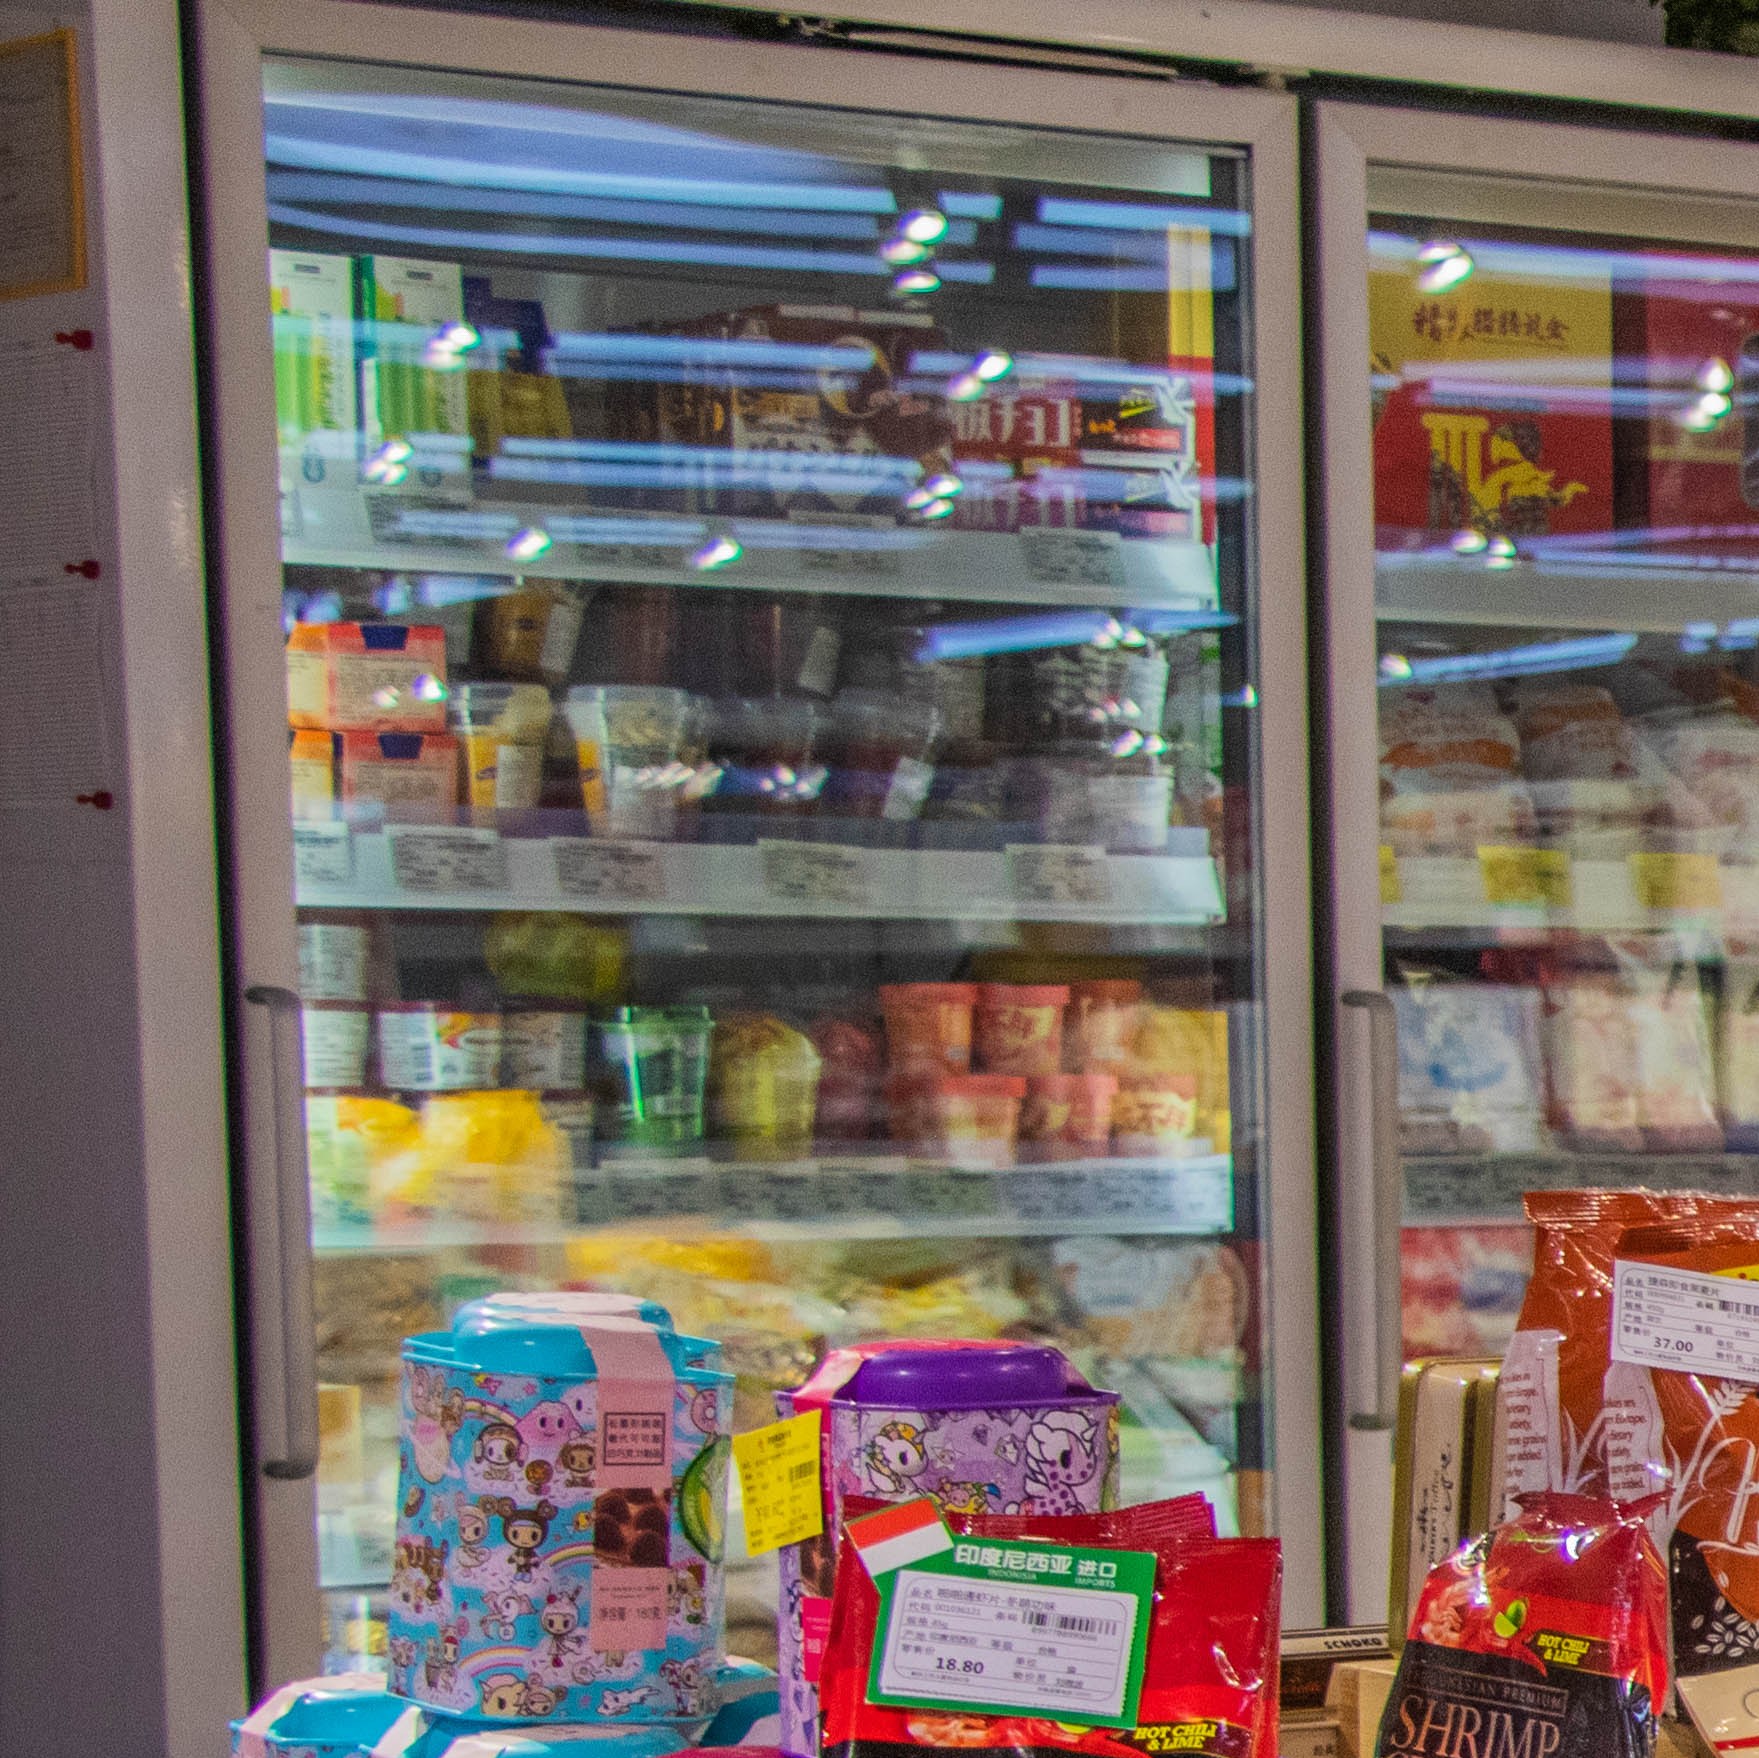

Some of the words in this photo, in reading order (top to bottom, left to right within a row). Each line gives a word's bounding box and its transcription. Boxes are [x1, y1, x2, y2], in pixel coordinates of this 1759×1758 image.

[1654, 1336, 1694, 1353] 37.00
[954, 1544, 1073, 1575] 印度尼西亚
[1077, 1559, 1117, 1579] 进口
[936, 1656, 984, 1674] 18.80
[1133, 1724, 1174, 1743] HOT
[1175, 1720, 1219, 1740] CHILI
